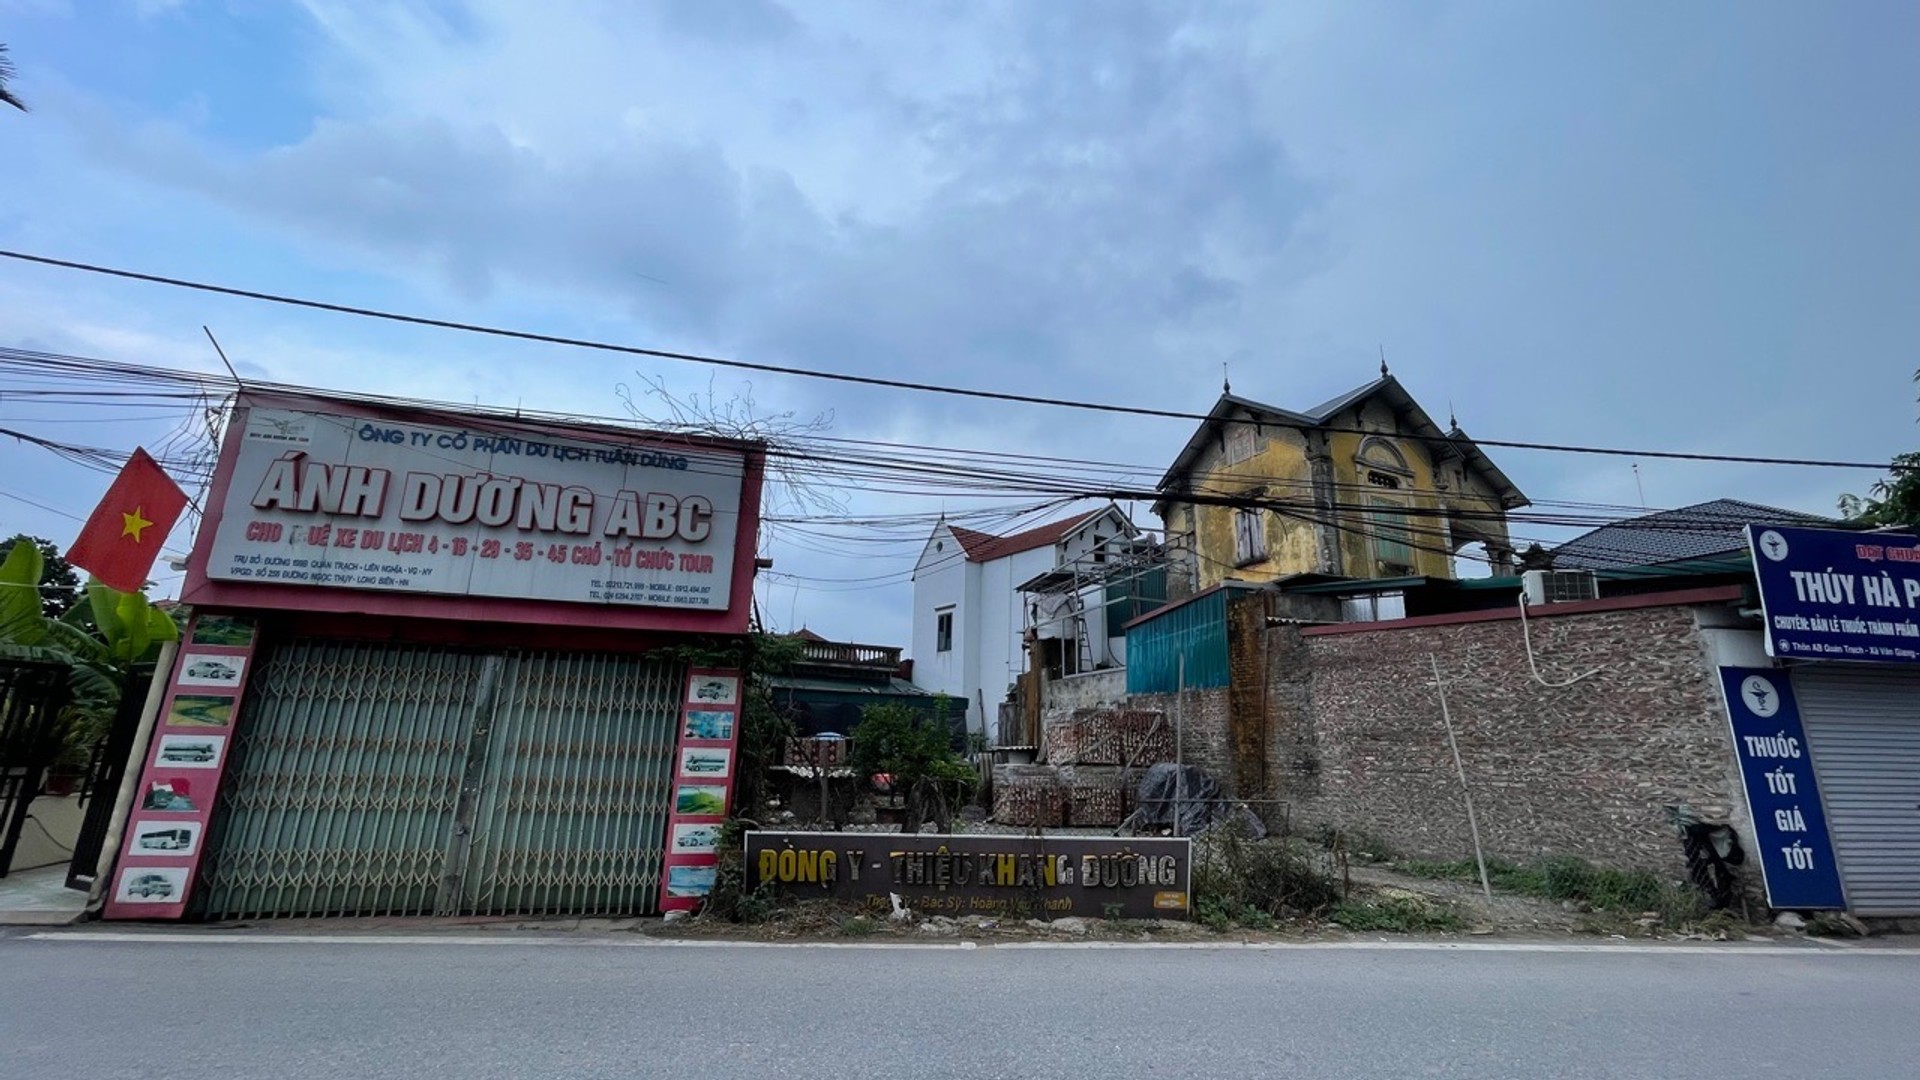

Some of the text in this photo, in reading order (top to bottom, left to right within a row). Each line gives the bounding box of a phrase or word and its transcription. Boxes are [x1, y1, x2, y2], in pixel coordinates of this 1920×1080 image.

[411, 432, 433, 446] TY
[437, 429, 468, 450] CỔ
[526, 442, 550, 458] DU
[554, 446, 590, 463] LỊCH
[251, 450, 713, 540] ÁNH DƯƠNG ABC
[246, 521, 283, 542] CHO
[334, 528, 358, 548] XE
[360, 530, 385, 550] DU
[388, 532, 424, 555] LỊCH
[428, 536, 439, 554] 4
[452, 537, 468, 556] 16
[547, 544, 568, 563] 45
[572, 542, 602, 565] CHỖ
[614, 543, 633, 568] TỔ
[636, 546, 675, 571] CHỨC
[679, 553, 713, 573] TOUR
[1790, 567, 1856, 605] THÚY
[1862, 570, 1901, 607] HÀ
[1743, 730, 1801, 759] THUỐC
[1764, 765, 1797, 795] TỐT
[1774, 805, 1807, 832] GIÁ
[846, 850, 864, 880] Y
[978, 853, 1074, 887] KHANG
[1782, 839, 1815, 870] TỐT
